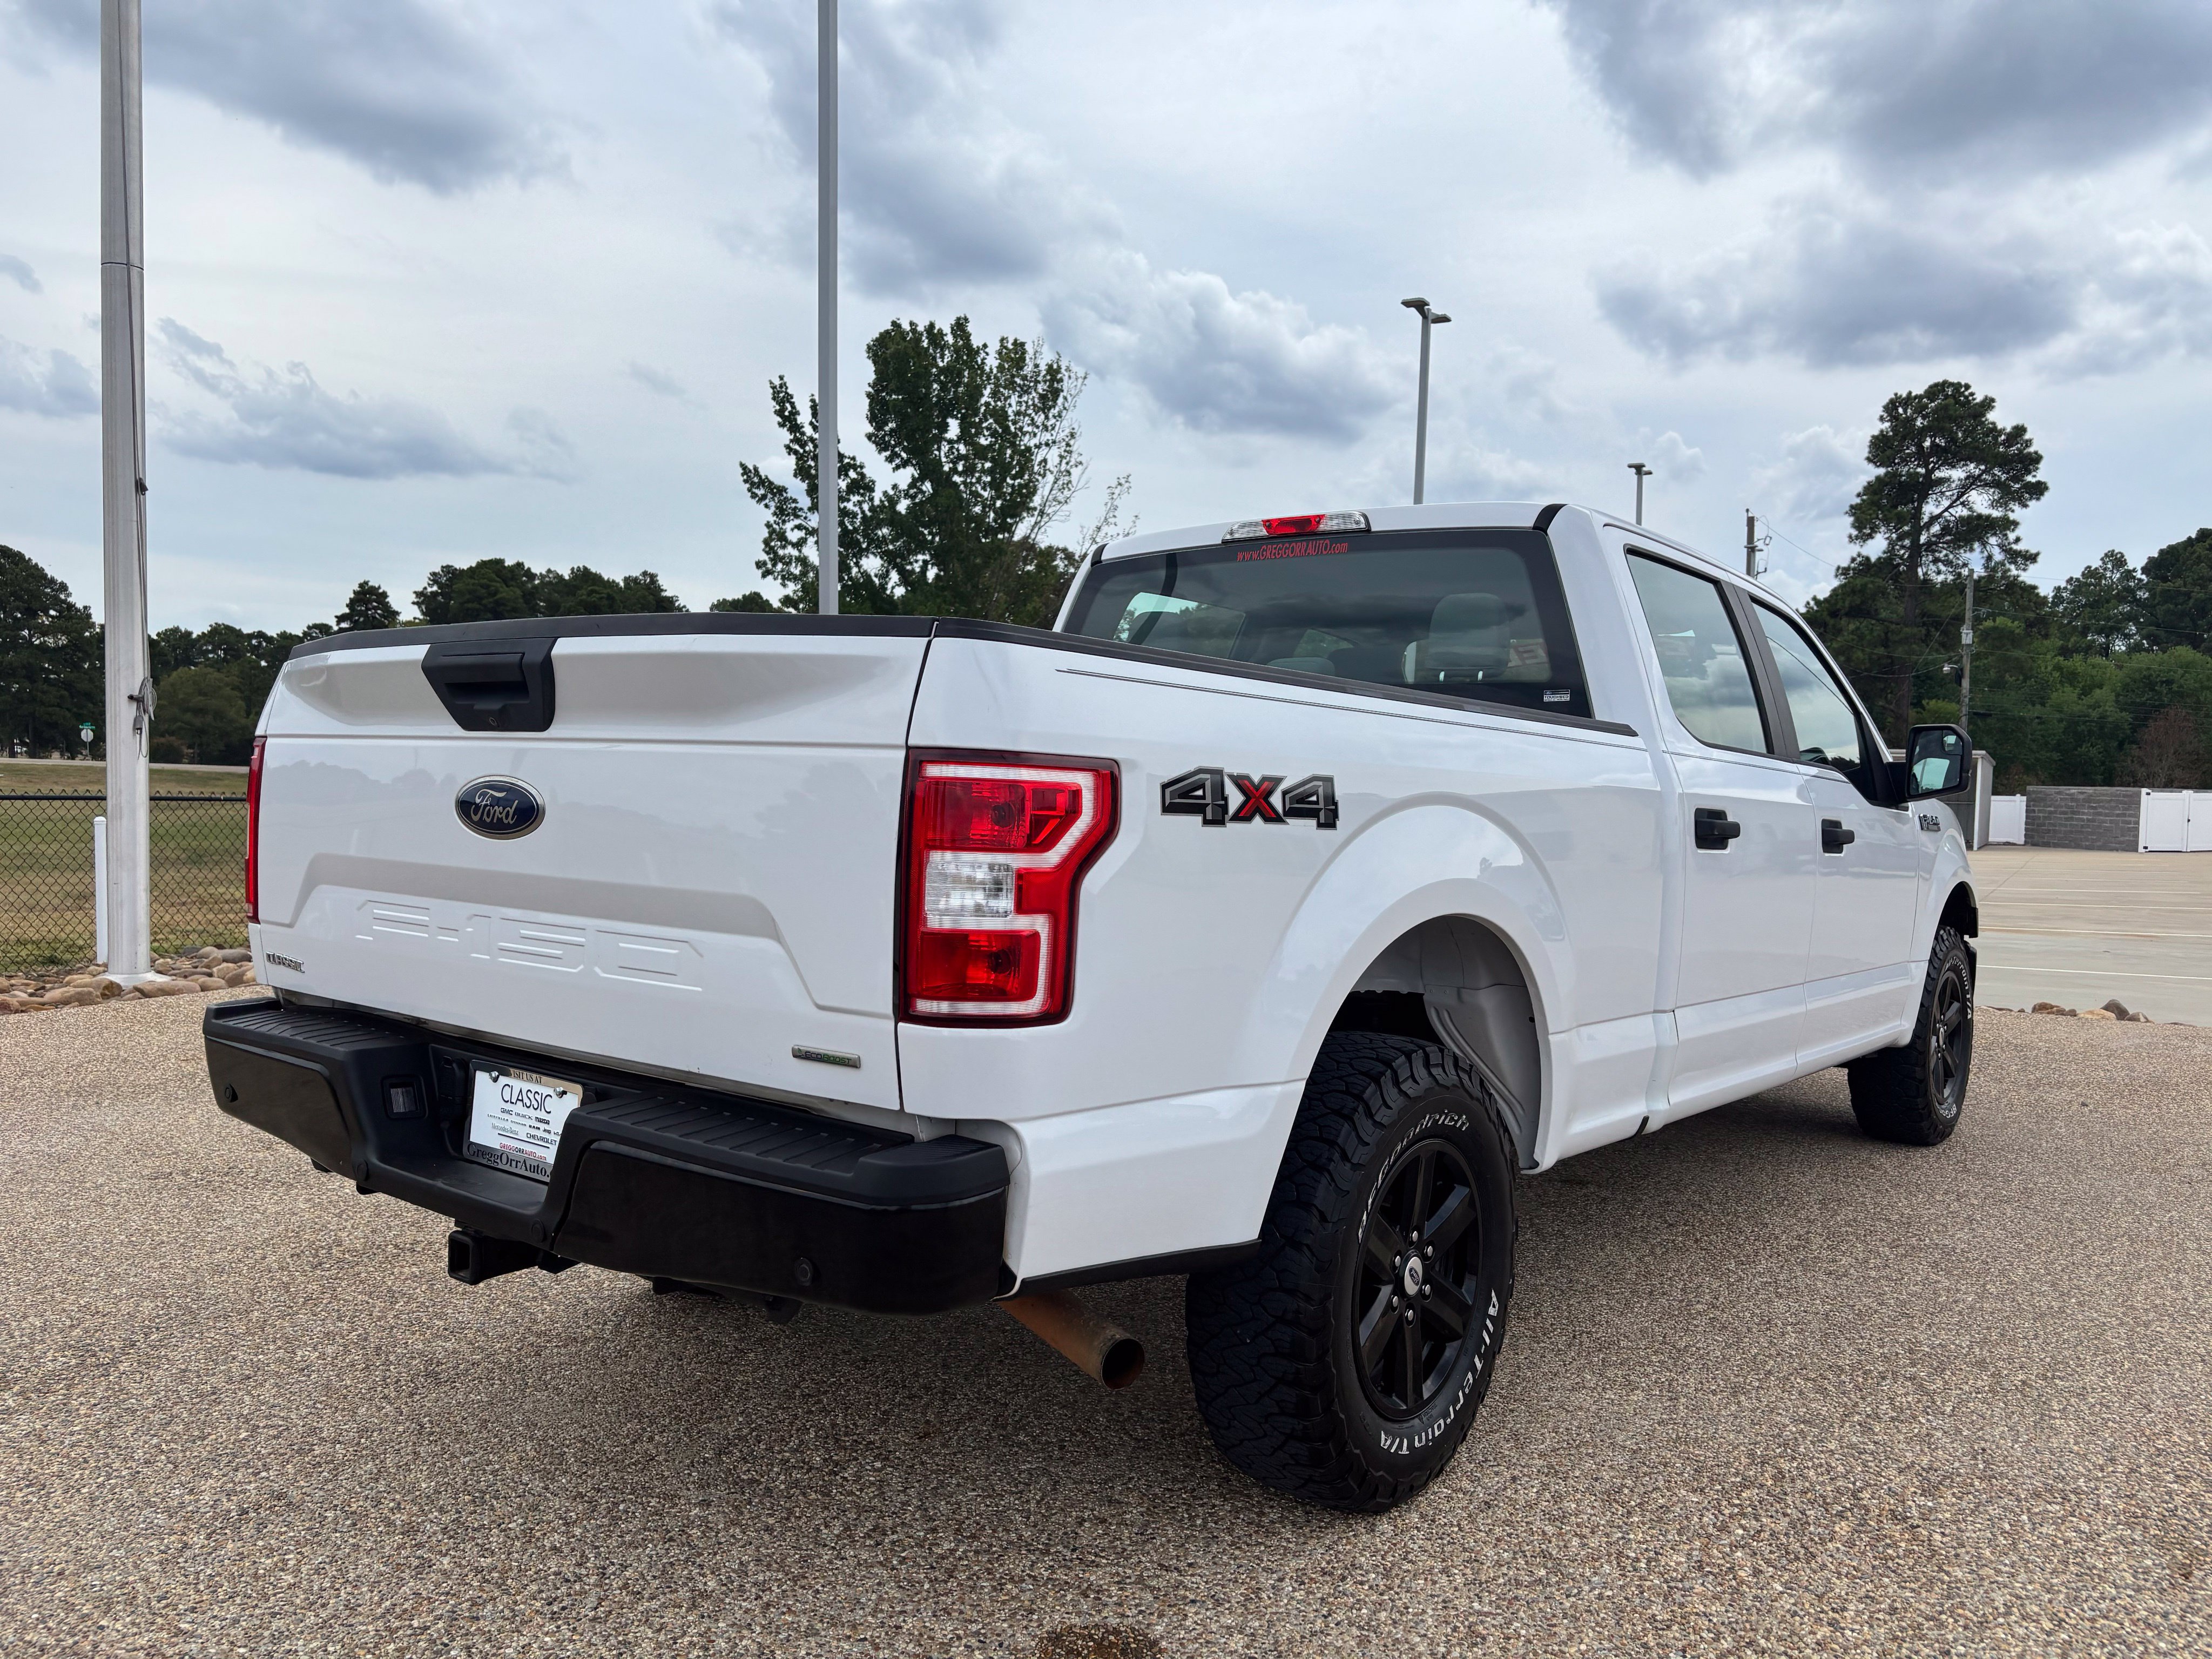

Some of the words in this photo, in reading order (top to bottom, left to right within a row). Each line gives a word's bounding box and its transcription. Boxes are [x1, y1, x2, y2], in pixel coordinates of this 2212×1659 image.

[1236, 539, 1348, 562] www.GREGGORRAUTO.com
[470, 788, 518, 825] Ford
[509, 1069, 524, 1080] VISIT
[526, 1073, 534, 1082] US
[535, 1076, 543, 1084] AT
[501, 1083, 552, 1114] CLASSIC
[527, 1132, 557, 1145] CHEVROLET
[500, 1142, 547, 1162] GREGGORRAUTO.com
[1380, 1430, 1410, 1454] T/A
